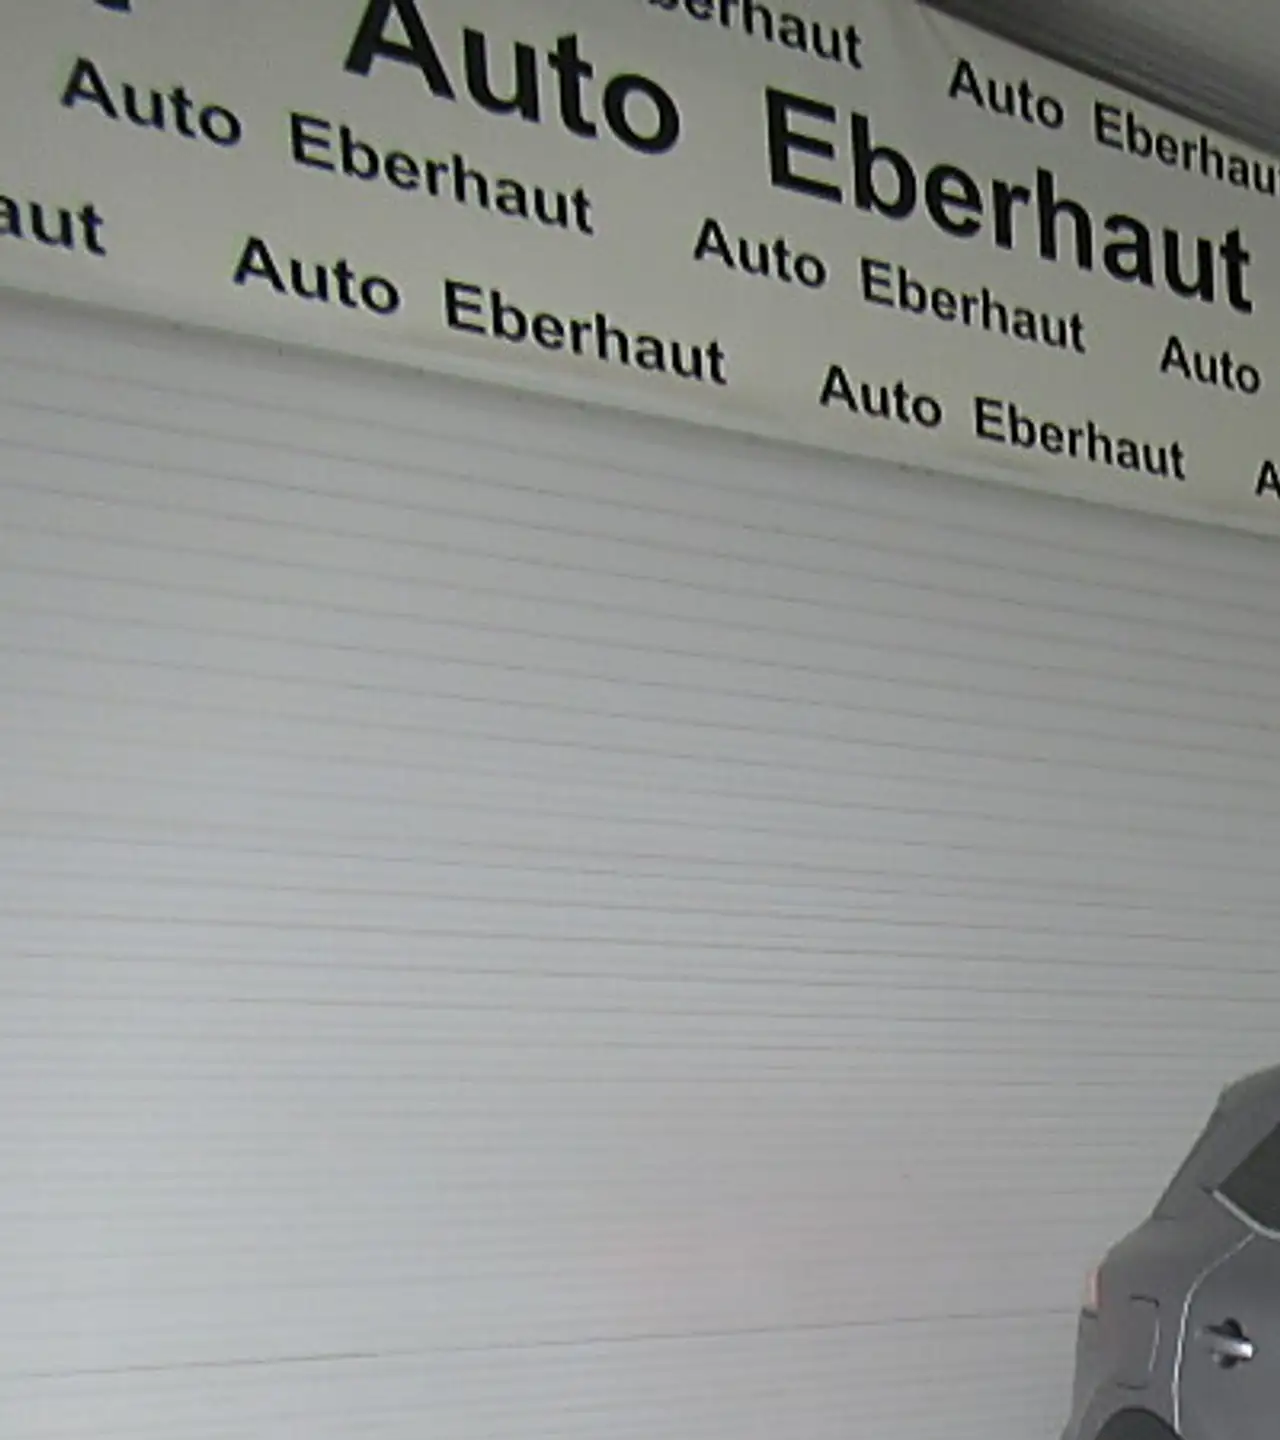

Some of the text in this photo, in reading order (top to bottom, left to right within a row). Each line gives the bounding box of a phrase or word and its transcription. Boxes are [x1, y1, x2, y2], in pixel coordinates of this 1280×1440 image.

[648, 0, 863, 70] erhaut
[948, 57, 1064, 130] Auto
[60, 56, 594, 236] Auto Eberhaut
[343, 0, 1254, 315] Auto Eberhaut
[234, 236, 728, 386] Auto Eberhaut
[693, 217, 1087, 354] Auto Eberhaut
[820, 363, 1186, 482] Auto Eberhaut
[1159, 334, 1261, 395] Auto
